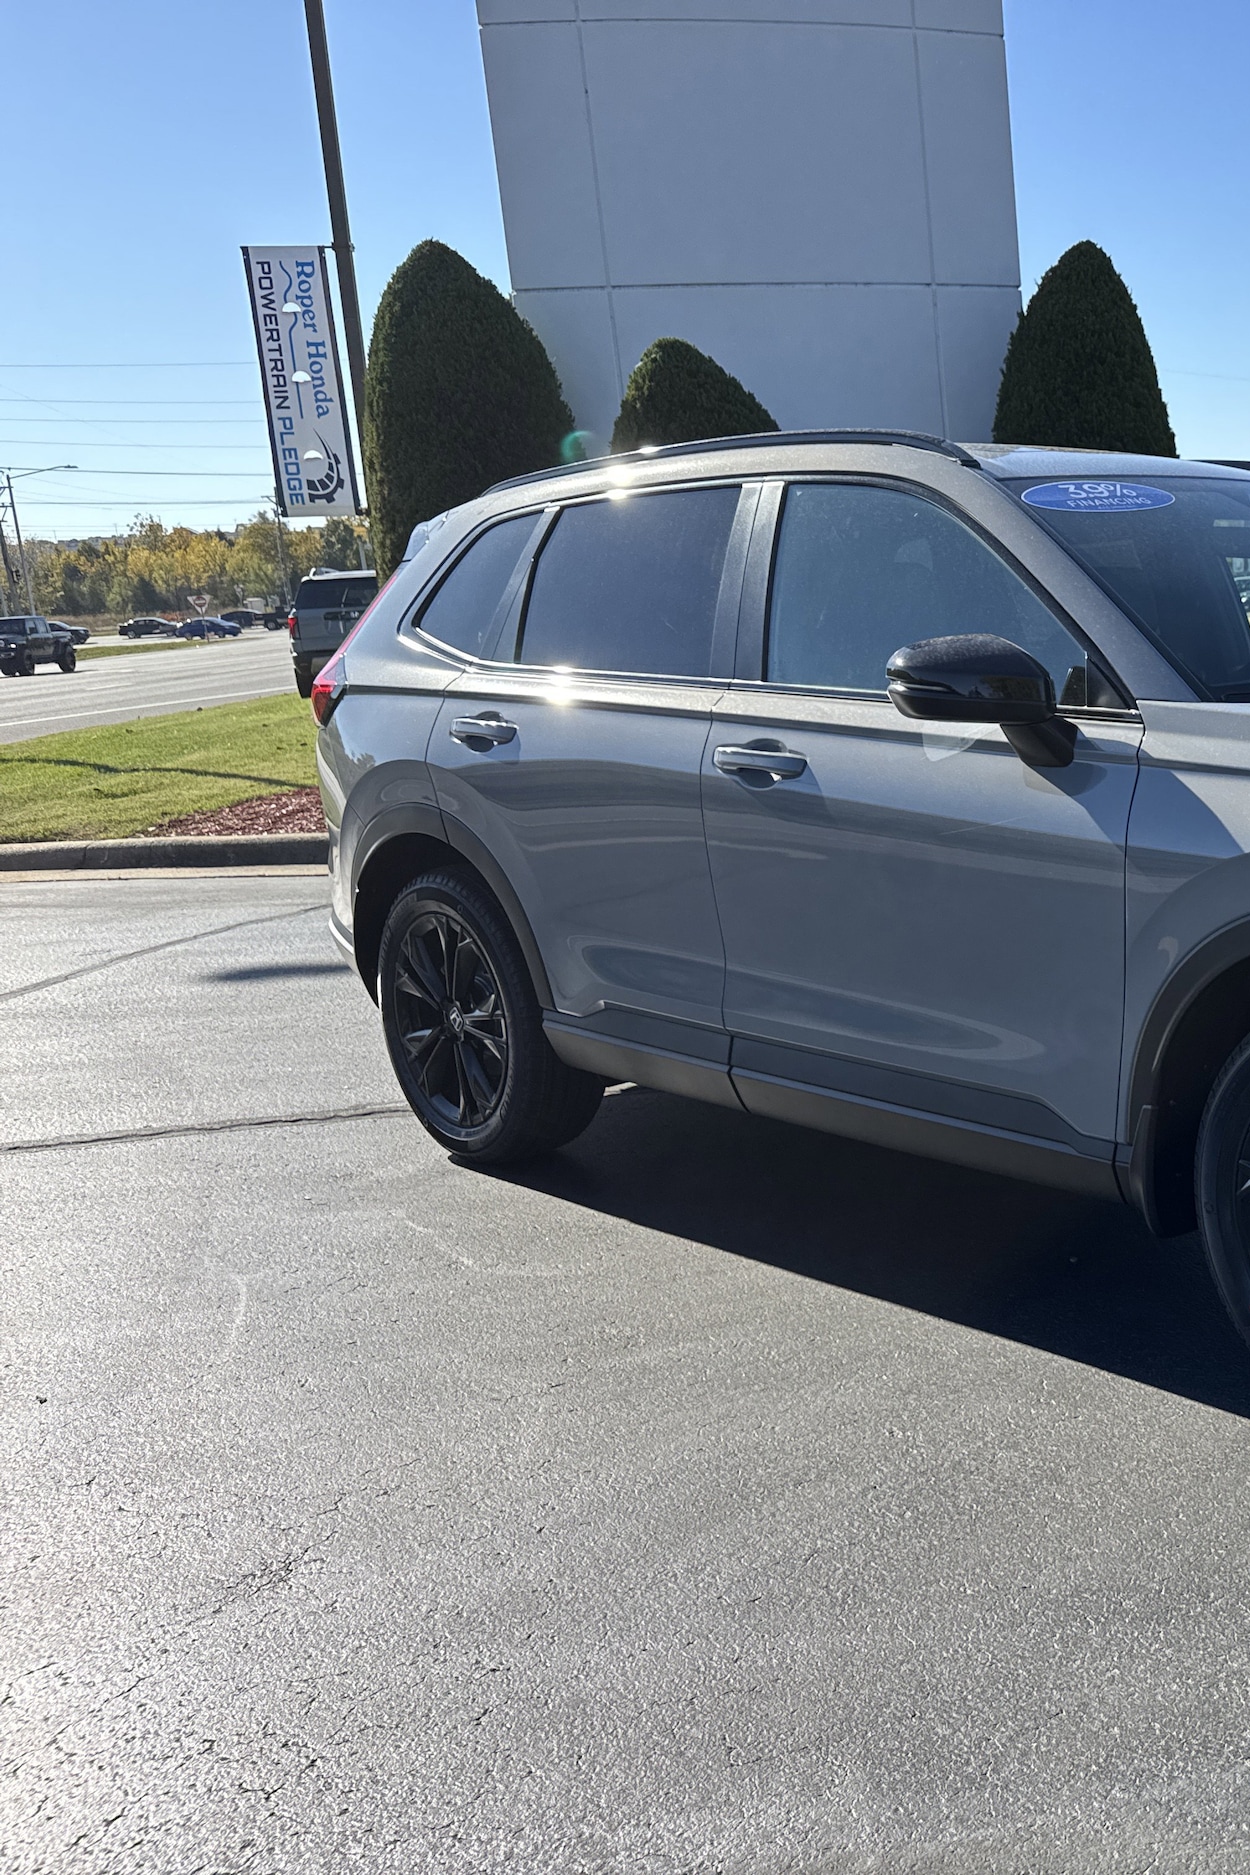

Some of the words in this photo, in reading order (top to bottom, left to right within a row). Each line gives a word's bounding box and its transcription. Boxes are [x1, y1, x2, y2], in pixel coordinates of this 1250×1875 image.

[295, 260, 318, 333] Roper
[257, 261, 290, 409] POWERTRAIN
[278, 417, 306, 506] PLEDGE
[306, 341, 334, 419] Honda
[1058, 483, 1136, 498] 3.9%
[1067, 497, 1151, 507] FINANCING
